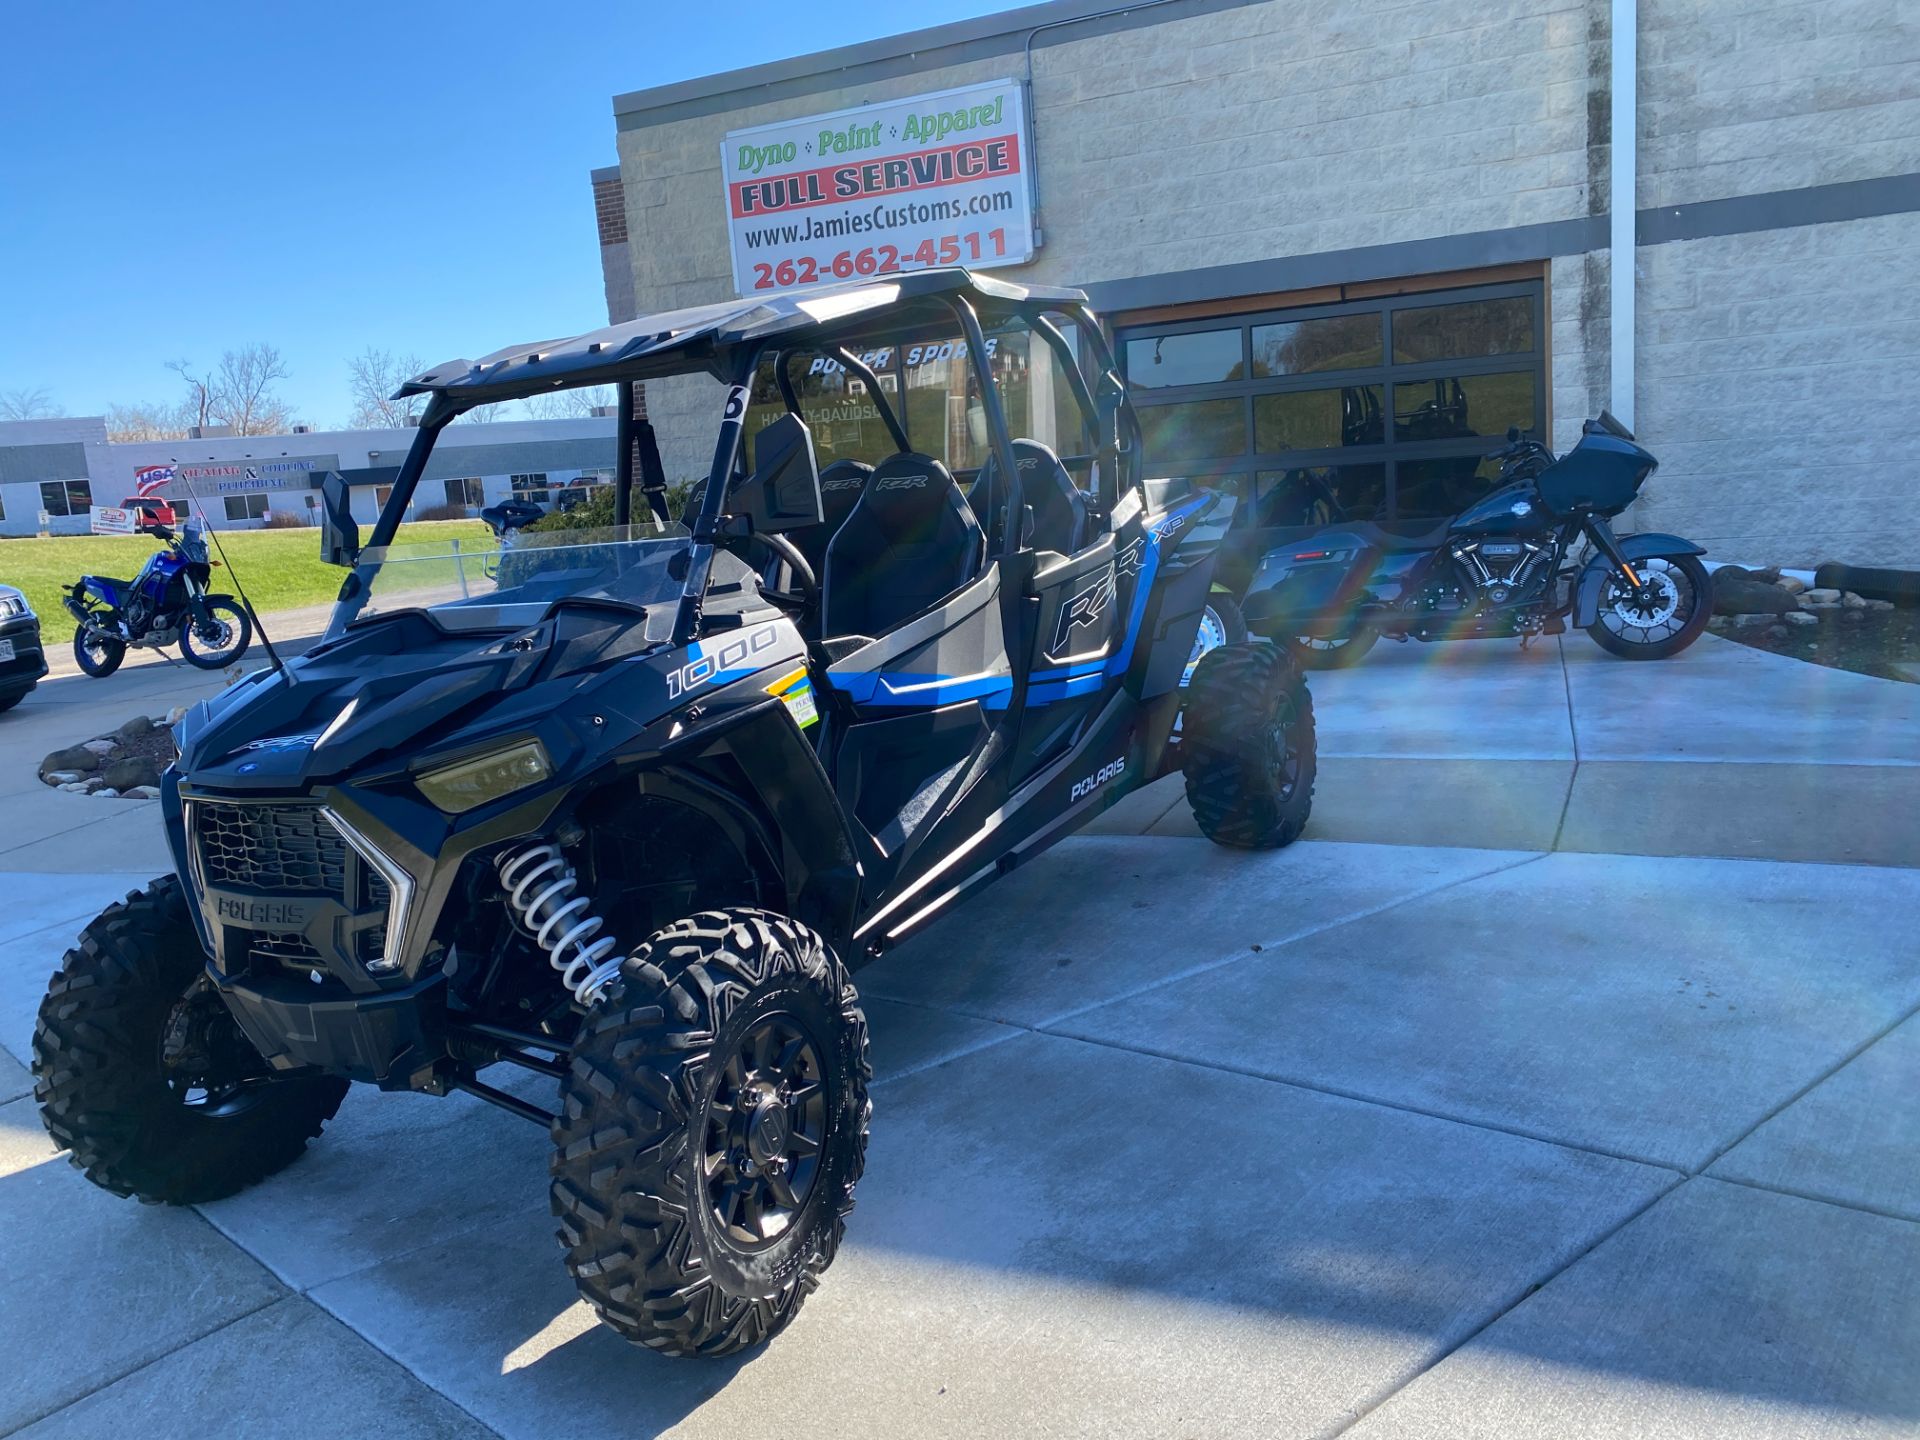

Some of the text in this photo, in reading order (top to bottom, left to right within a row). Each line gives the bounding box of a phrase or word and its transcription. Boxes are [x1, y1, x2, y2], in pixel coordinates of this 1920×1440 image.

[738, 95, 1004, 175] Dyno Paint Apparel
[741, 140, 1010, 213] FULL SERVICE
[745, 190, 1013, 249] www.JamiesCustoms.com
[754, 228, 1006, 290] 262-662-4511
[906, 338, 998, 366] SPORS
[140, 468, 176, 484] USA
[875, 475, 929, 492] RZR
[1152, 515, 1185, 545] XP
[666, 624, 778, 700] 1000
[1070, 755, 1125, 803] POLARIS
[218, 896, 305, 924] POLARIS
